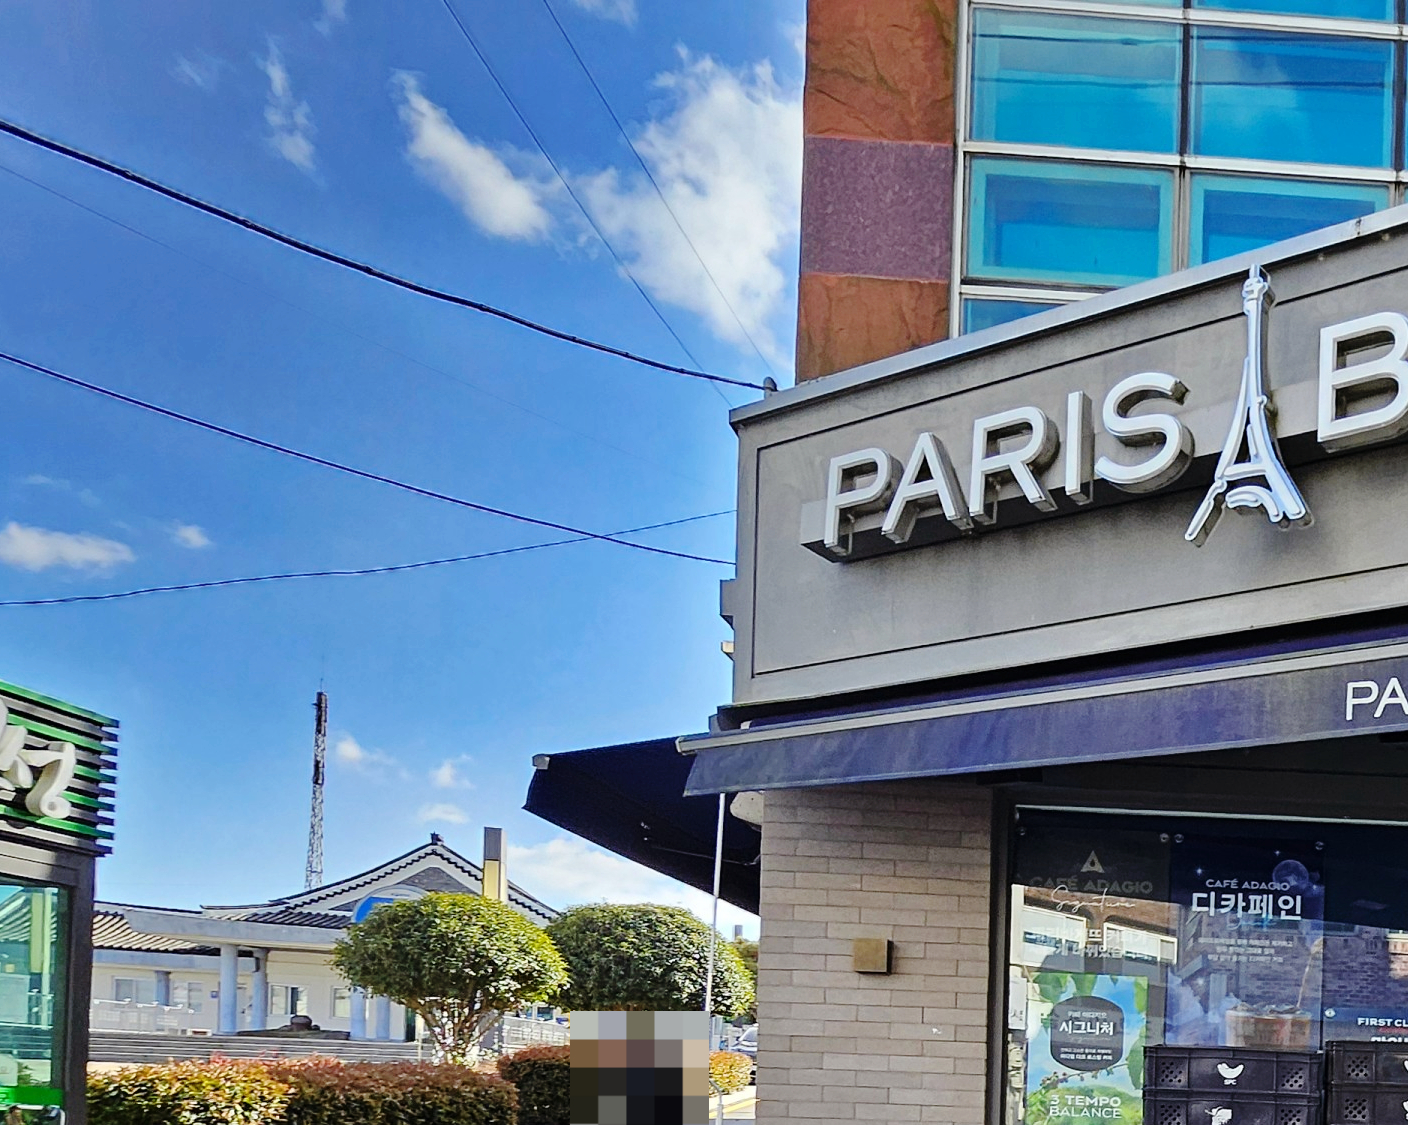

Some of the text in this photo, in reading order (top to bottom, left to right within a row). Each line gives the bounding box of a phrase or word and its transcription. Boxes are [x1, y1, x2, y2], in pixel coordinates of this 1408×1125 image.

[823, 371, 1194, 555] PARIS
[1083, 879, 1154, 894] ADAGIO
[1205, 878, 1291, 892] CAFÉ ADAGIO
[1191, 891, 1303, 921] 디카페인
[1059, 1020, 1114, 1036] 시그니처
[1357, 1017, 1393, 1027] FIRST
[1050, 1094, 1122, 1107] 3 TEMPO
[1049, 1105, 1122, 1119] BALANCE
